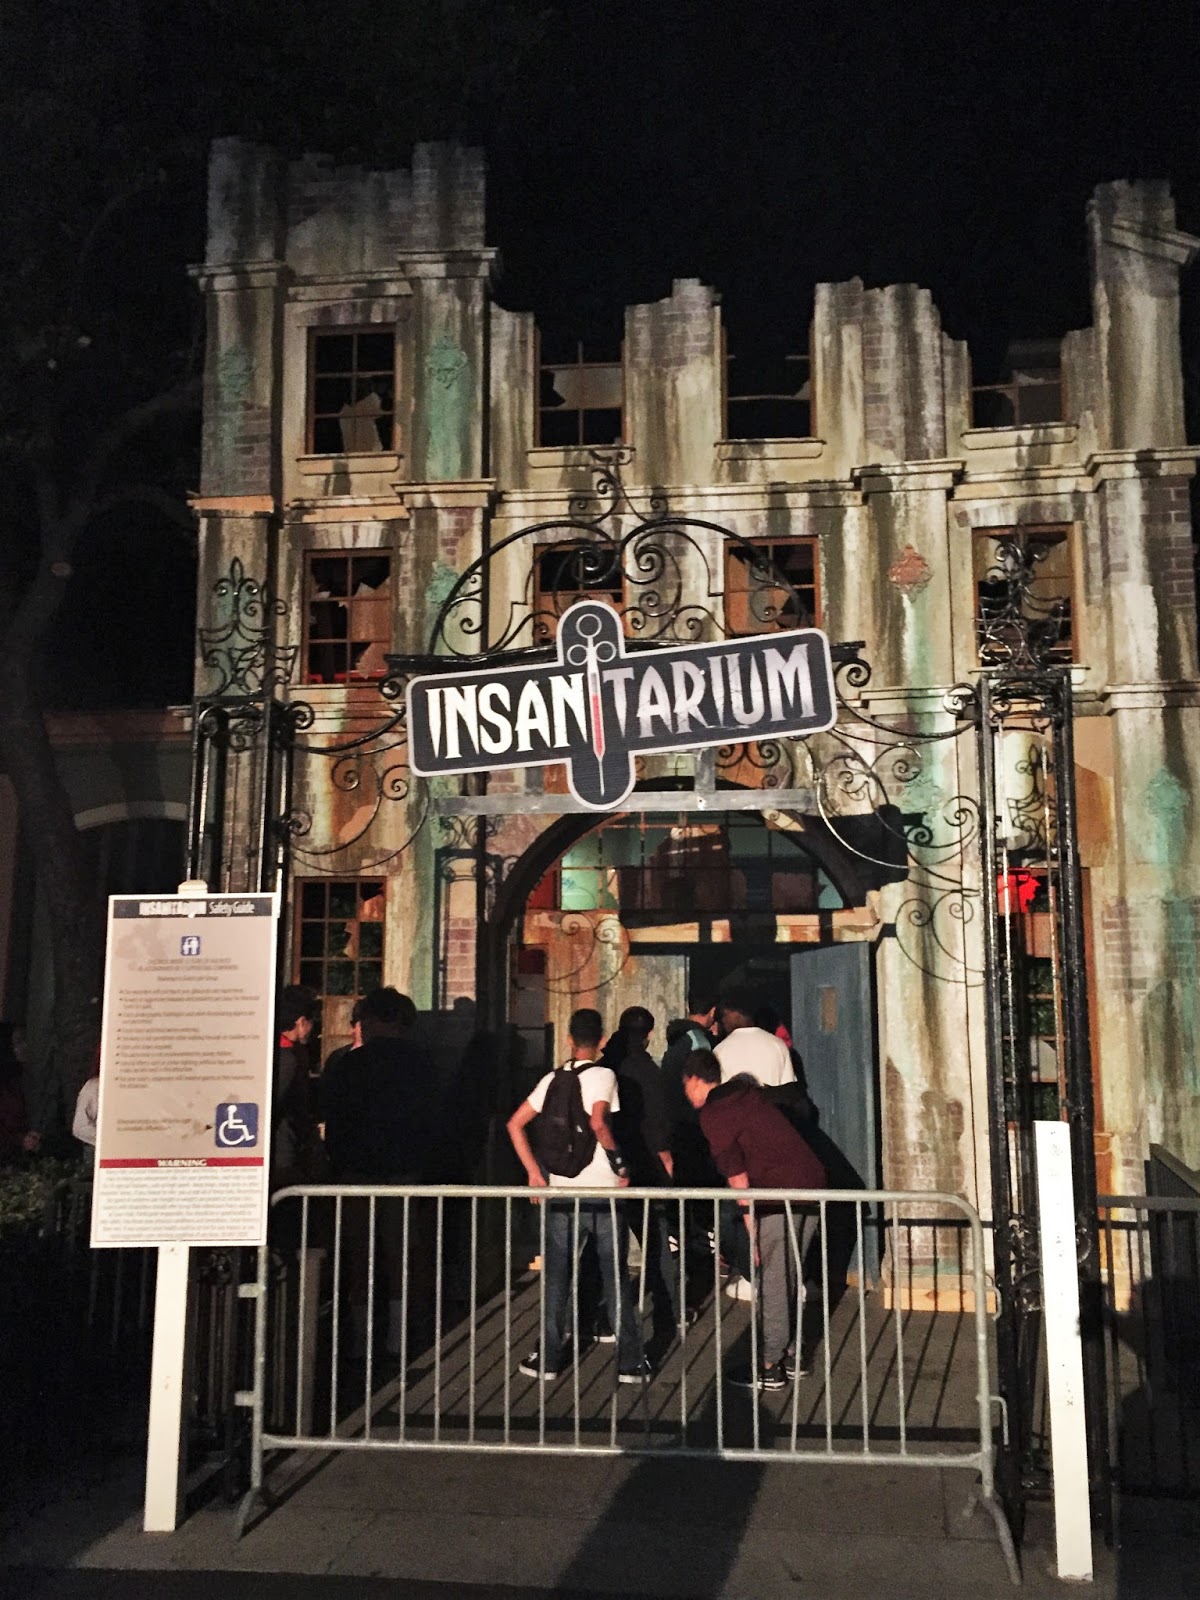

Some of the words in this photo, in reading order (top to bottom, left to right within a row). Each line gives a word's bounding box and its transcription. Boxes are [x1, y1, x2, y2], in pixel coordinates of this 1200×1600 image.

[208, 901, 232, 917] Safety
[232, 901, 255, 915] Guide
[157, 1159, 208, 1168] WARNING
